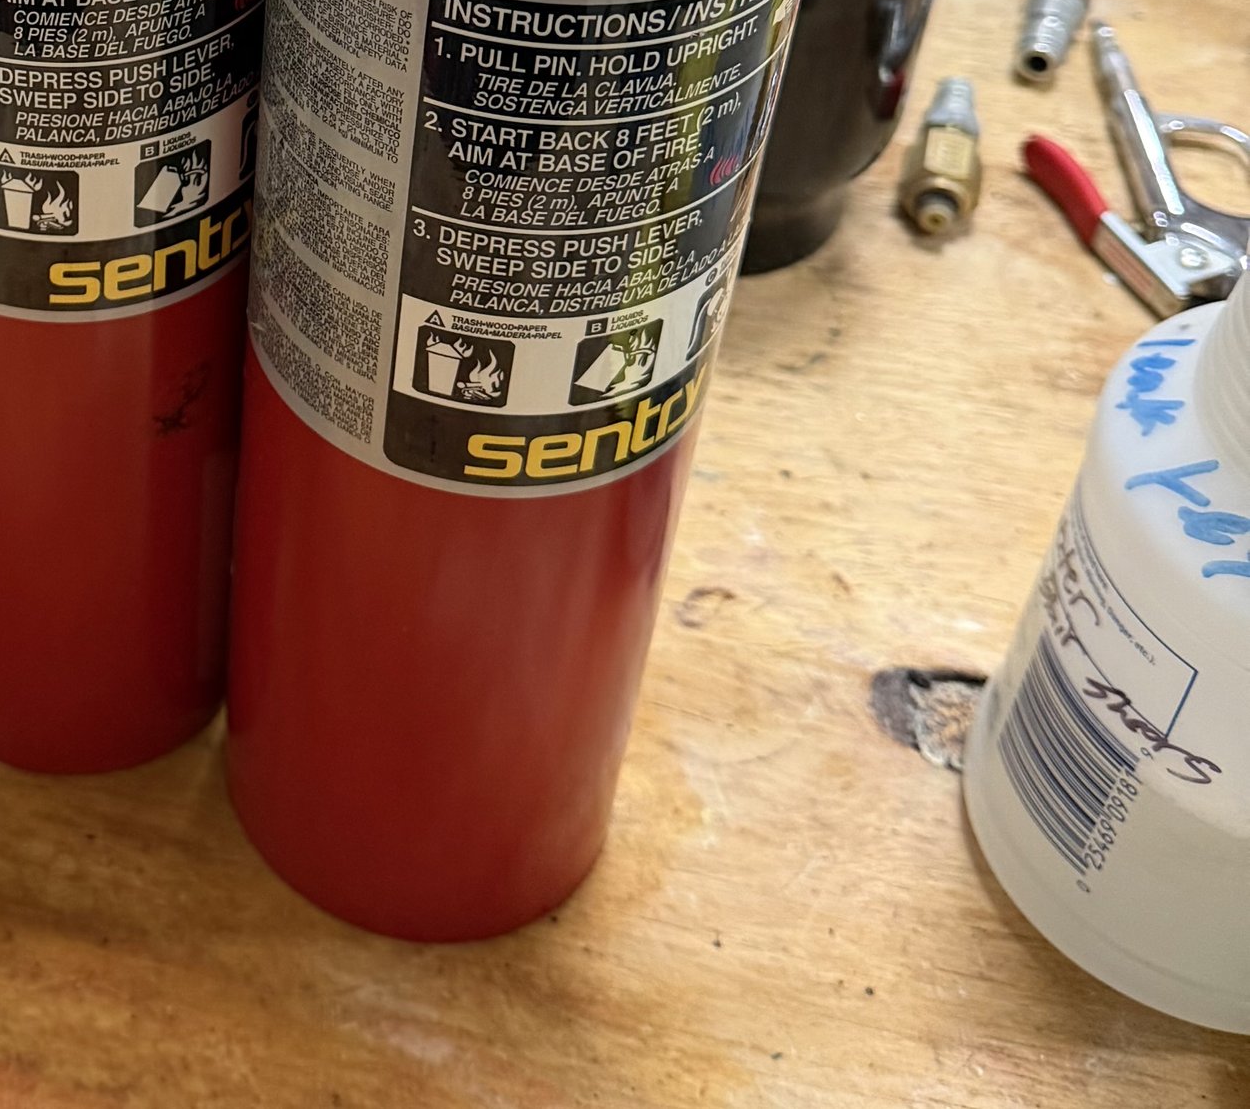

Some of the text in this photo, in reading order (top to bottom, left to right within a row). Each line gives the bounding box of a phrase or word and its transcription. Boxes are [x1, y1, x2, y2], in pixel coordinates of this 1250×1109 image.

[108, 60, 168, 87] PUSH
[172, 35, 235, 70] LEVER,
[433, 14, 758, 77] 1. PULL PIN. HOLD UPRIGHT.
[473, 62, 742, 117] SOSTENGA VERTICALMENTE.
[477, 71, 677, 98] TIRE DE LA CLAVIJA.
[424, 110, 443, 133] 2.
[451, 117, 534, 149] START
[538, 127, 608, 151] BACK
[615, 130, 630, 148] 8
[635, 112, 694, 146] FEET
[695, 104, 714, 134] (2
[448, 132, 701, 174] AIM AT BASE OF FIRE.
[464, 169, 574, 193] COMIENCE
[576, 172, 644, 193] DESDE
[702, 149, 714, 163] A
[369, 171, 396, 189] WHEN
[461, 186, 475, 201] 8
[478, 189, 523, 209] PIES
[526, 193, 548, 212] (2
[587, 183, 663, 210] APUNTE
[663, 177, 679, 194] A
[412, 210, 704, 259] 3. DEPRESS PUSH LEVER,
[460, 198, 661, 227] LA BASE DEL FUEGO.
[436, 240, 679, 280] SWEEP SIDE TO SIDE.
[449, 290, 545, 314] PALANCA,
[548, 284, 654, 313] DISTRIBUYA
[657, 273, 678, 291] DE
[679, 252, 717, 281] LADO
[451, 252, 695, 298] PRESIONE HACIA ABAJO LA
[609, 315, 649, 332] LIQUIDOS
[611, 309, 644, 323] LIQUIDS
[463, 365, 705, 478] sentry
[1106, 770, 1143, 823] 09181
[1084, 819, 1117, 871] 25469
